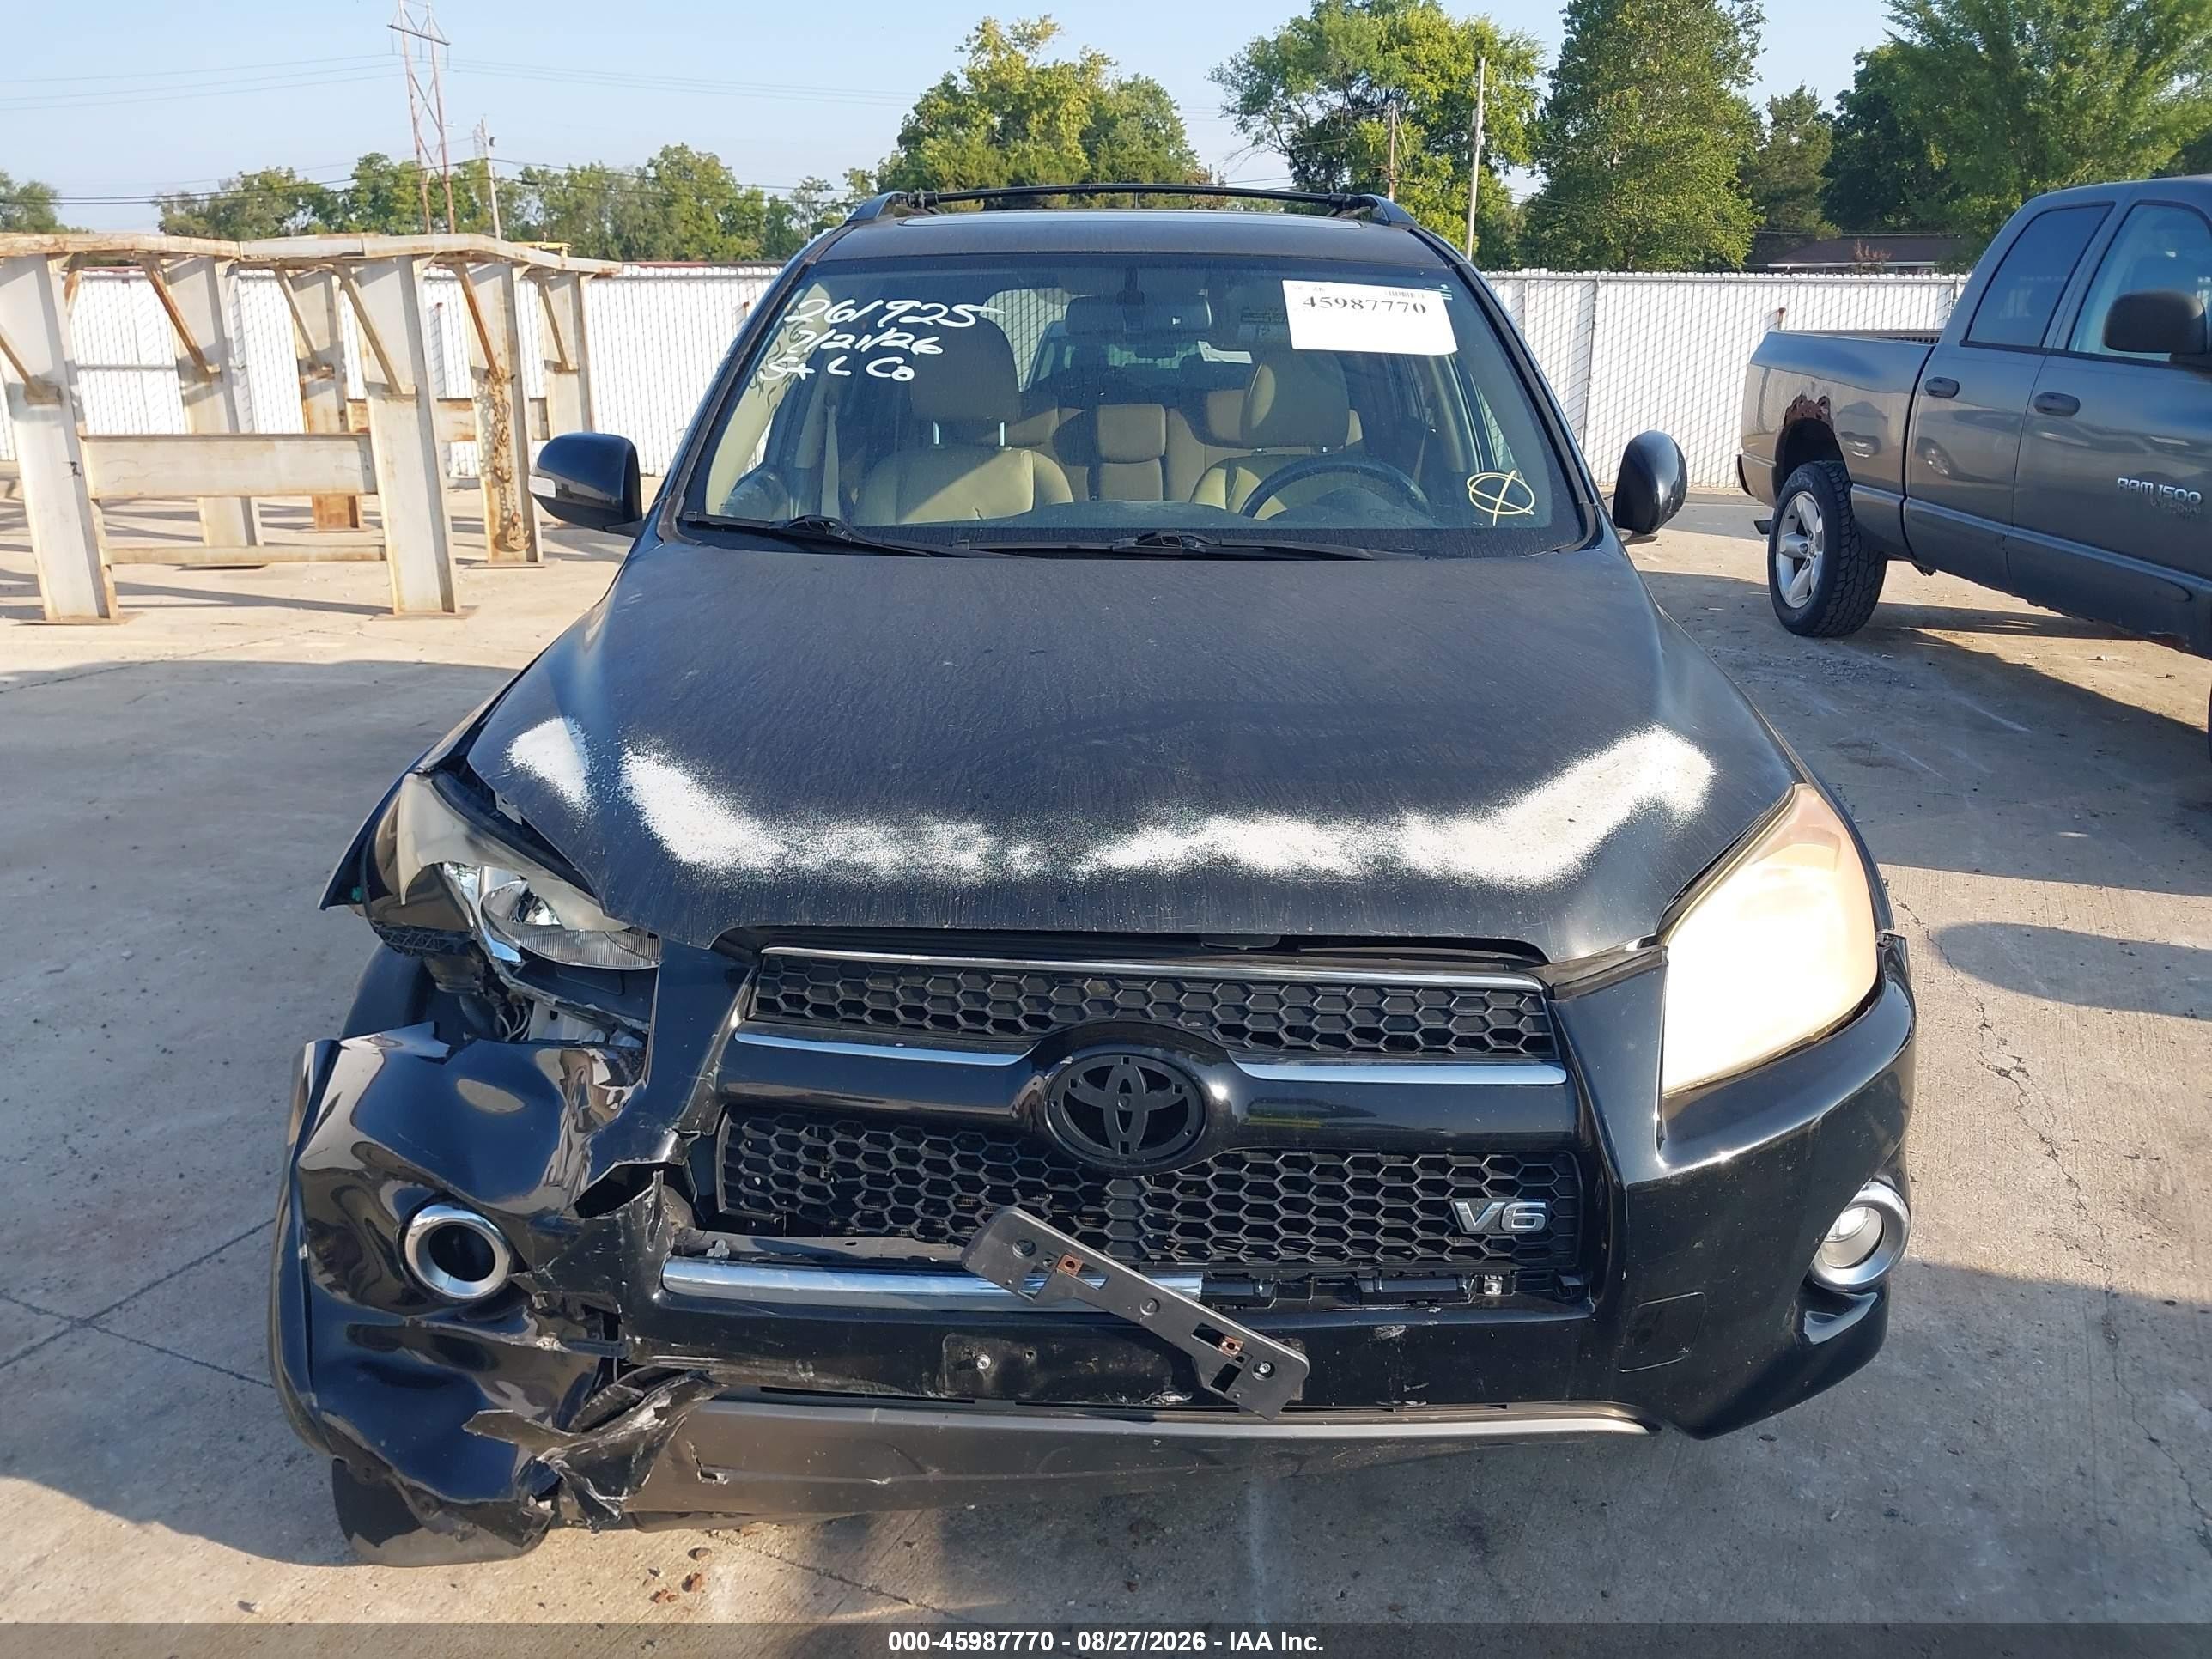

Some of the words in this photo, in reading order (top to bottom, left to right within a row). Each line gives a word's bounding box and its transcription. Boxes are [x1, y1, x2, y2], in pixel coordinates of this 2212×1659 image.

[784, 299, 1005, 328] 261925
[1302, 295, 1427, 314] 45987770
[787, 327, 943, 355] 7/21/26
[2117, 477, 2154, 495] RAM
[2158, 483, 2203, 505] 1500
[1455, 1201, 1546, 1233] V6
